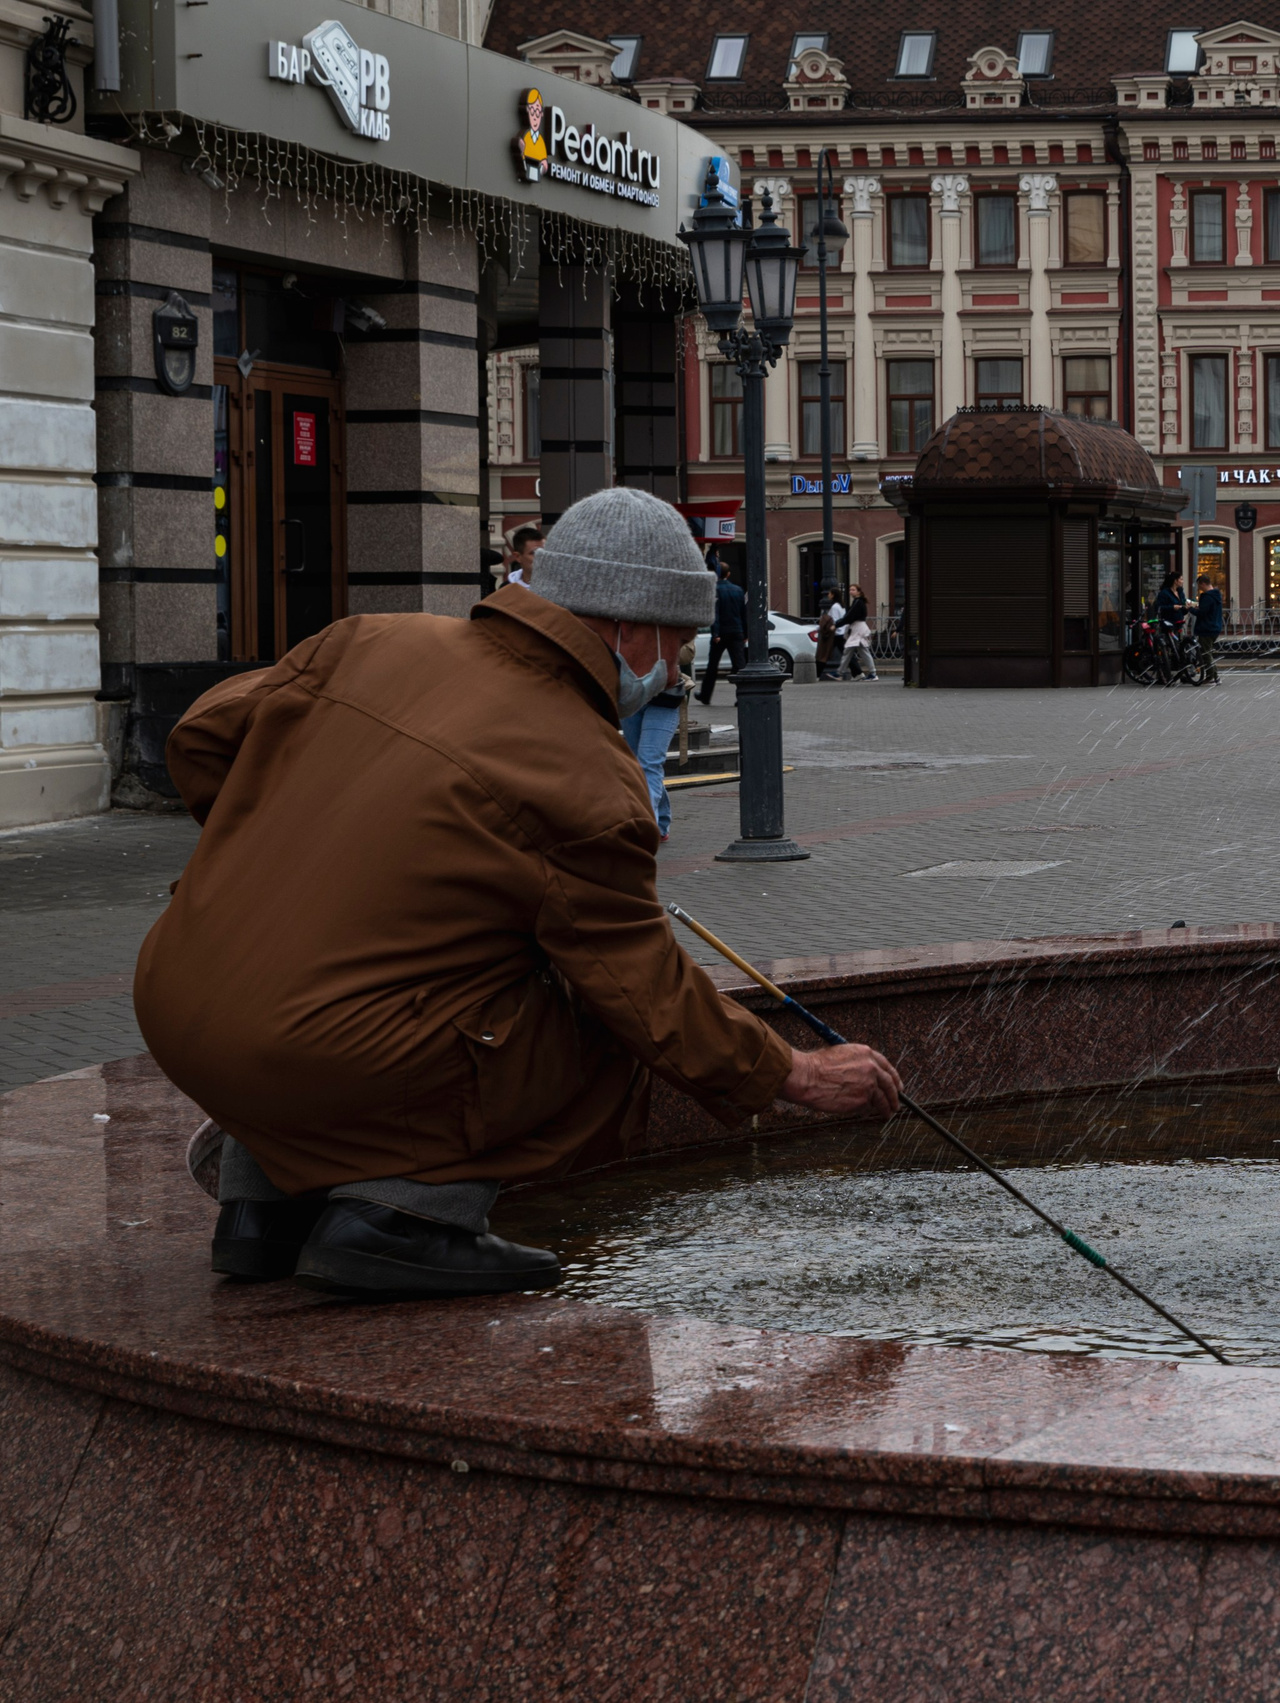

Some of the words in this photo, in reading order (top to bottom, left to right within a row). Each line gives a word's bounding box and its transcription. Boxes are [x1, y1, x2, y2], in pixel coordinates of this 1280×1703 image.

[277, 40, 311, 85] БАР
[359, 107, 390, 141] КЛАБ
[551, 105, 661, 189] Pedant.ru
[551, 163, 581, 184] РЕМОНТ
[582, 173, 589, 186] И
[589, 177, 615, 194] ОБМЕН
[617, 182, 660, 207] СМАРТФОНОВ
[172, 326, 188, 338] 82
